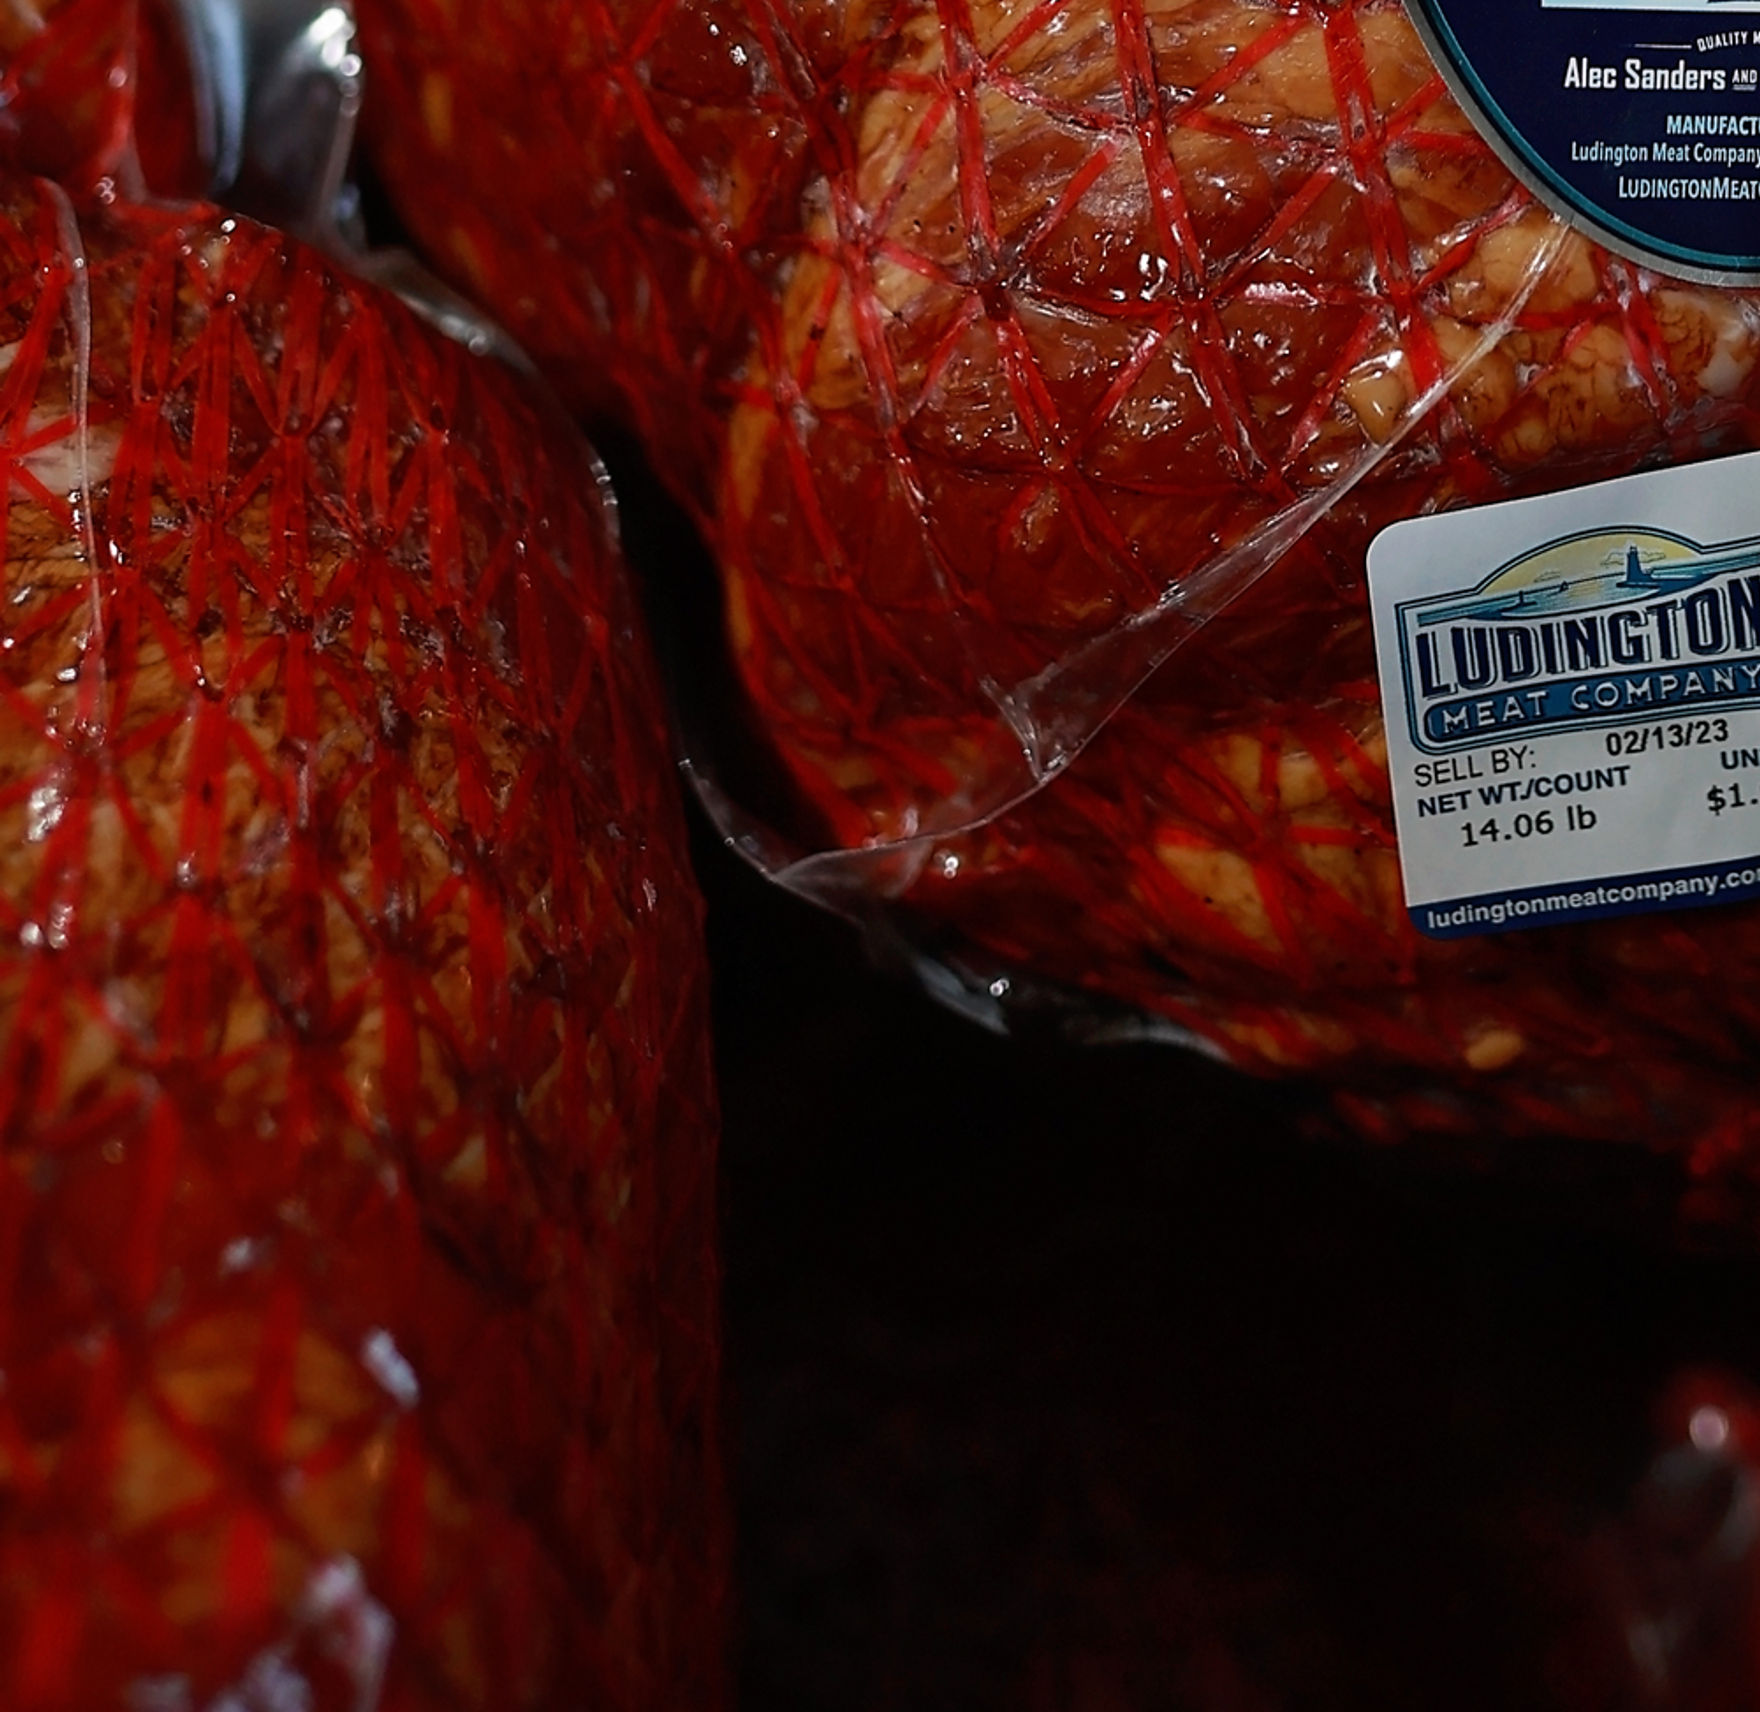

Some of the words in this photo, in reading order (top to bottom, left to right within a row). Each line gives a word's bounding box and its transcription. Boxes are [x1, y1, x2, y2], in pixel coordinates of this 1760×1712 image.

[1697, 31, 1748, 53] QUALITY
[1564, 57, 1617, 89] Alec
[1624, 59, 1726, 91] Sanders
[1732, 68, 1758, 85] AND
[1571, 141, 1648, 167] Ludington
[1652, 142, 1690, 162] Meat
[1440, 690, 1548, 735] MEAT
[1414, 753, 1483, 788] SELL
[1492, 744, 1536, 774] BY:
[1605, 719, 1729, 757] 02/13/23
[1418, 790, 1473, 818] NET
[1480, 765, 1631, 806] WT./COUNT
[1462, 810, 1555, 848] 14.06
[1567, 805, 1597, 831] lb
